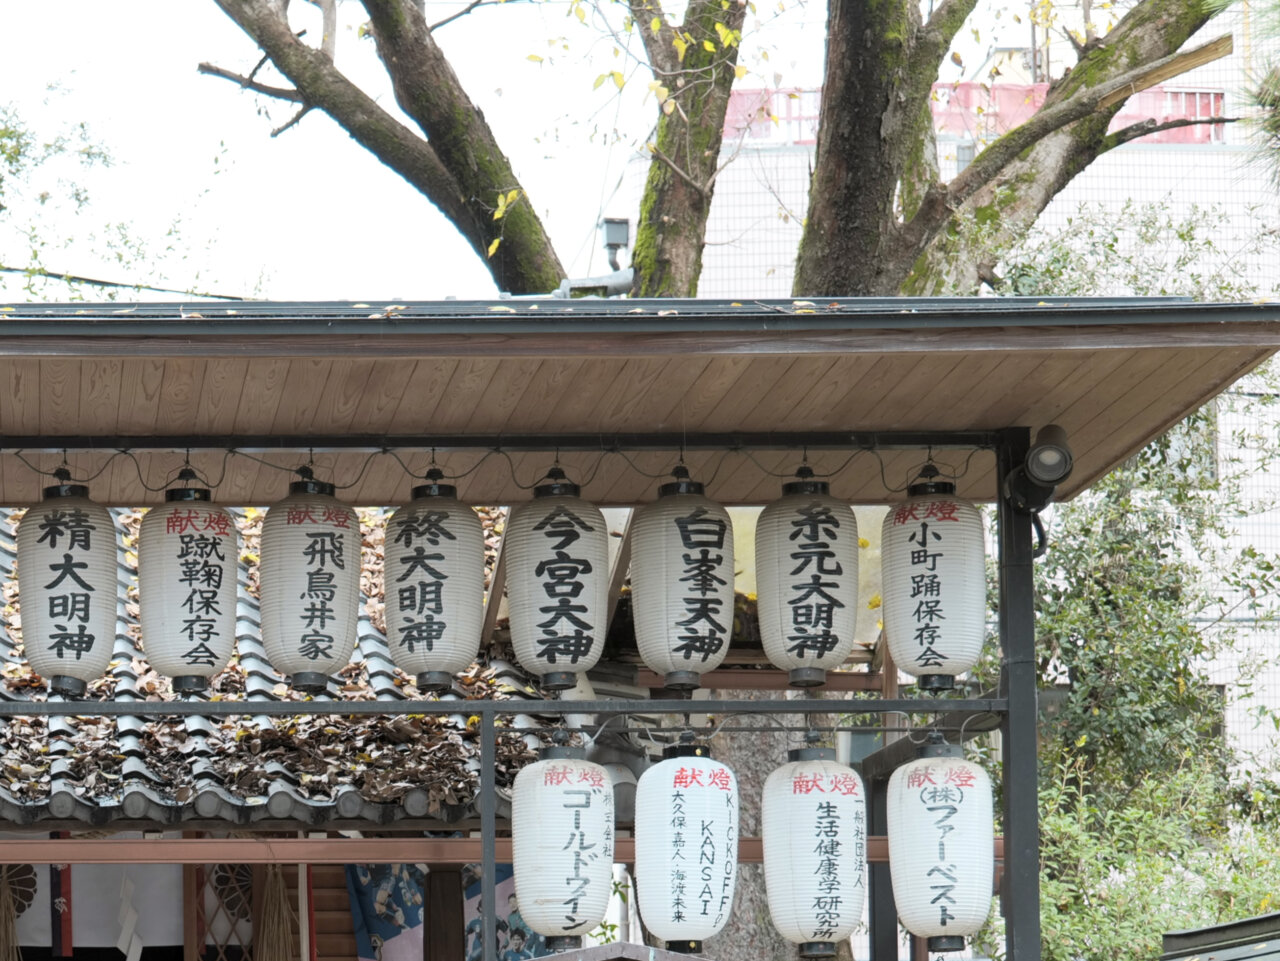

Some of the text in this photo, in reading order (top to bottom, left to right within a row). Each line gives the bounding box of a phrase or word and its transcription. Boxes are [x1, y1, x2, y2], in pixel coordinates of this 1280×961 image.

[37, 509, 97, 660] 精大明神
[177, 535, 225, 666] 蹴鞠保存会
[299, 531, 345, 659] 飛鳥井家
[394, 510, 457, 653] 柊大明神
[533, 506, 595, 663] 今宮大神
[673, 507, 727, 662] 白峯天神
[786, 503, 845, 659] 糸元大明神
[908, 522, 949, 668] 小町踊保存会
[700, 819, 716, 917] KANSAI
[812, 801, 843, 939] 生活健康学研究所
[853, 798, 865, 890] 一般社団法人
[925, 806, 959, 927] ファーベスト
